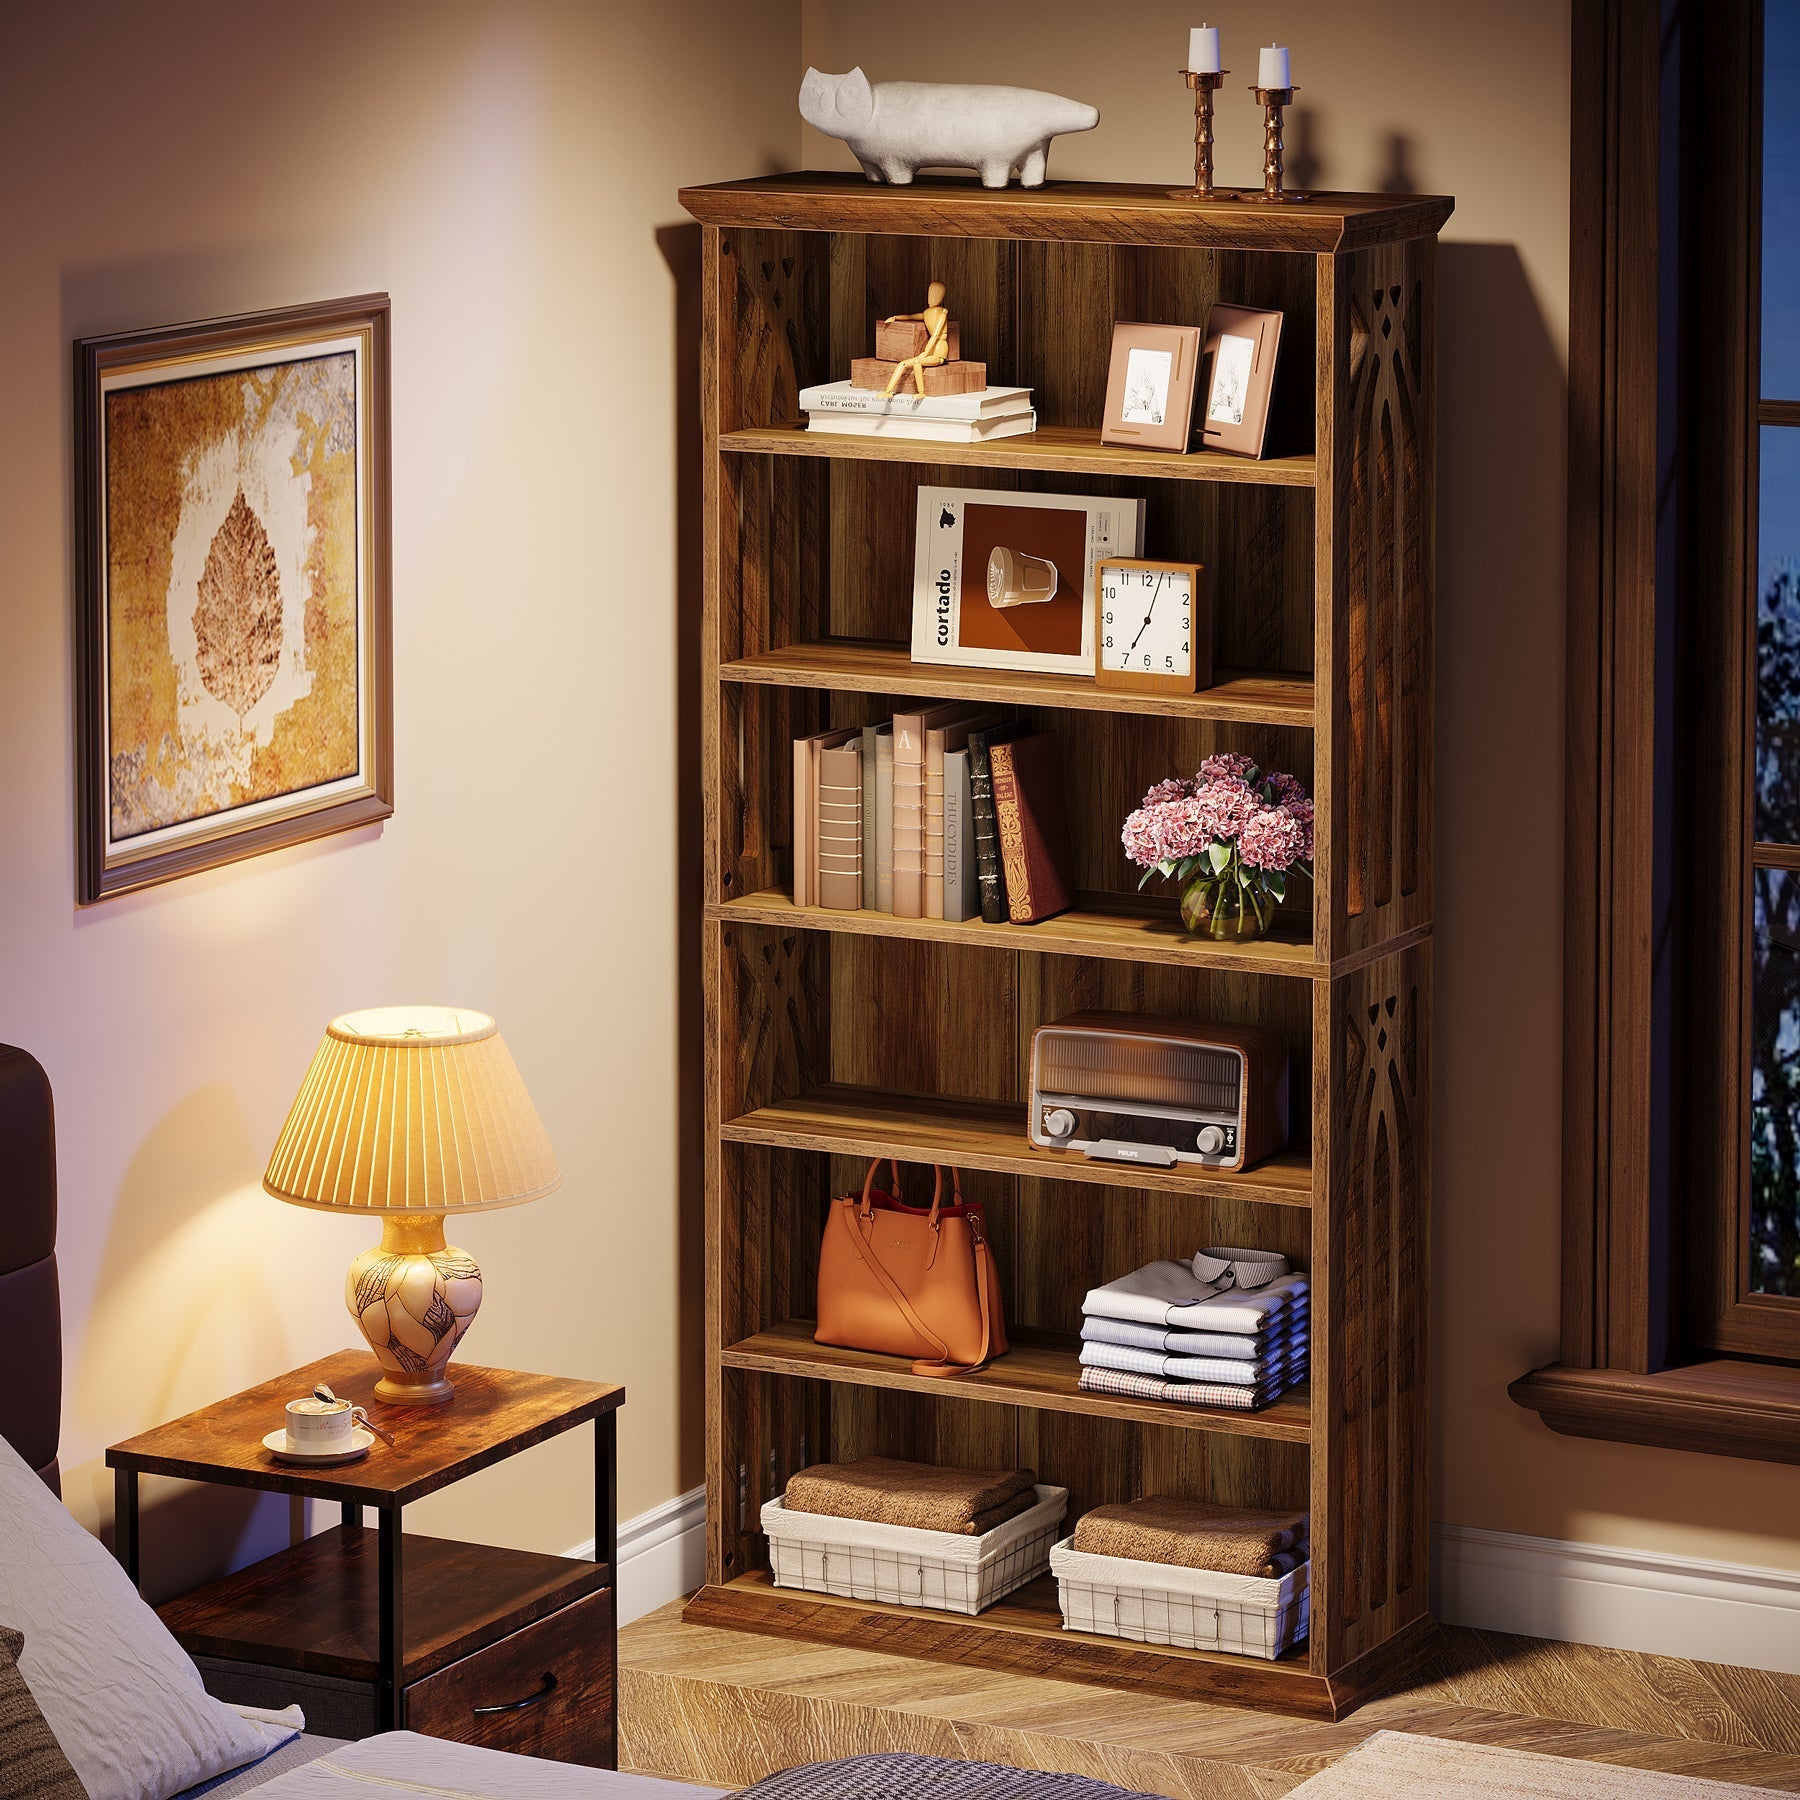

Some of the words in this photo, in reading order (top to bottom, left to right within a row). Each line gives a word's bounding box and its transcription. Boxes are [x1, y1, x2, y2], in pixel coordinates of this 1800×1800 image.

[1121, 573, 1129, 585] 11
[1142, 574, 1153, 587] 12
[1105, 586, 1116, 599] 10
[1182, 593, 1190, 606] 2
[936, 569, 951, 646] cortado
[1106, 612, 1113, 624] 9
[1182, 617, 1190, 629] 3
[1106, 636, 1114, 648] 8
[1182, 641, 1189, 653] 4
[1122, 652, 1130, 665] 7
[1143, 654, 1151, 667] 6
[1165, 656, 1173, 668] 5
[898, 729, 912, 750] A
[947, 791, 956, 886] THUCYDIDES
